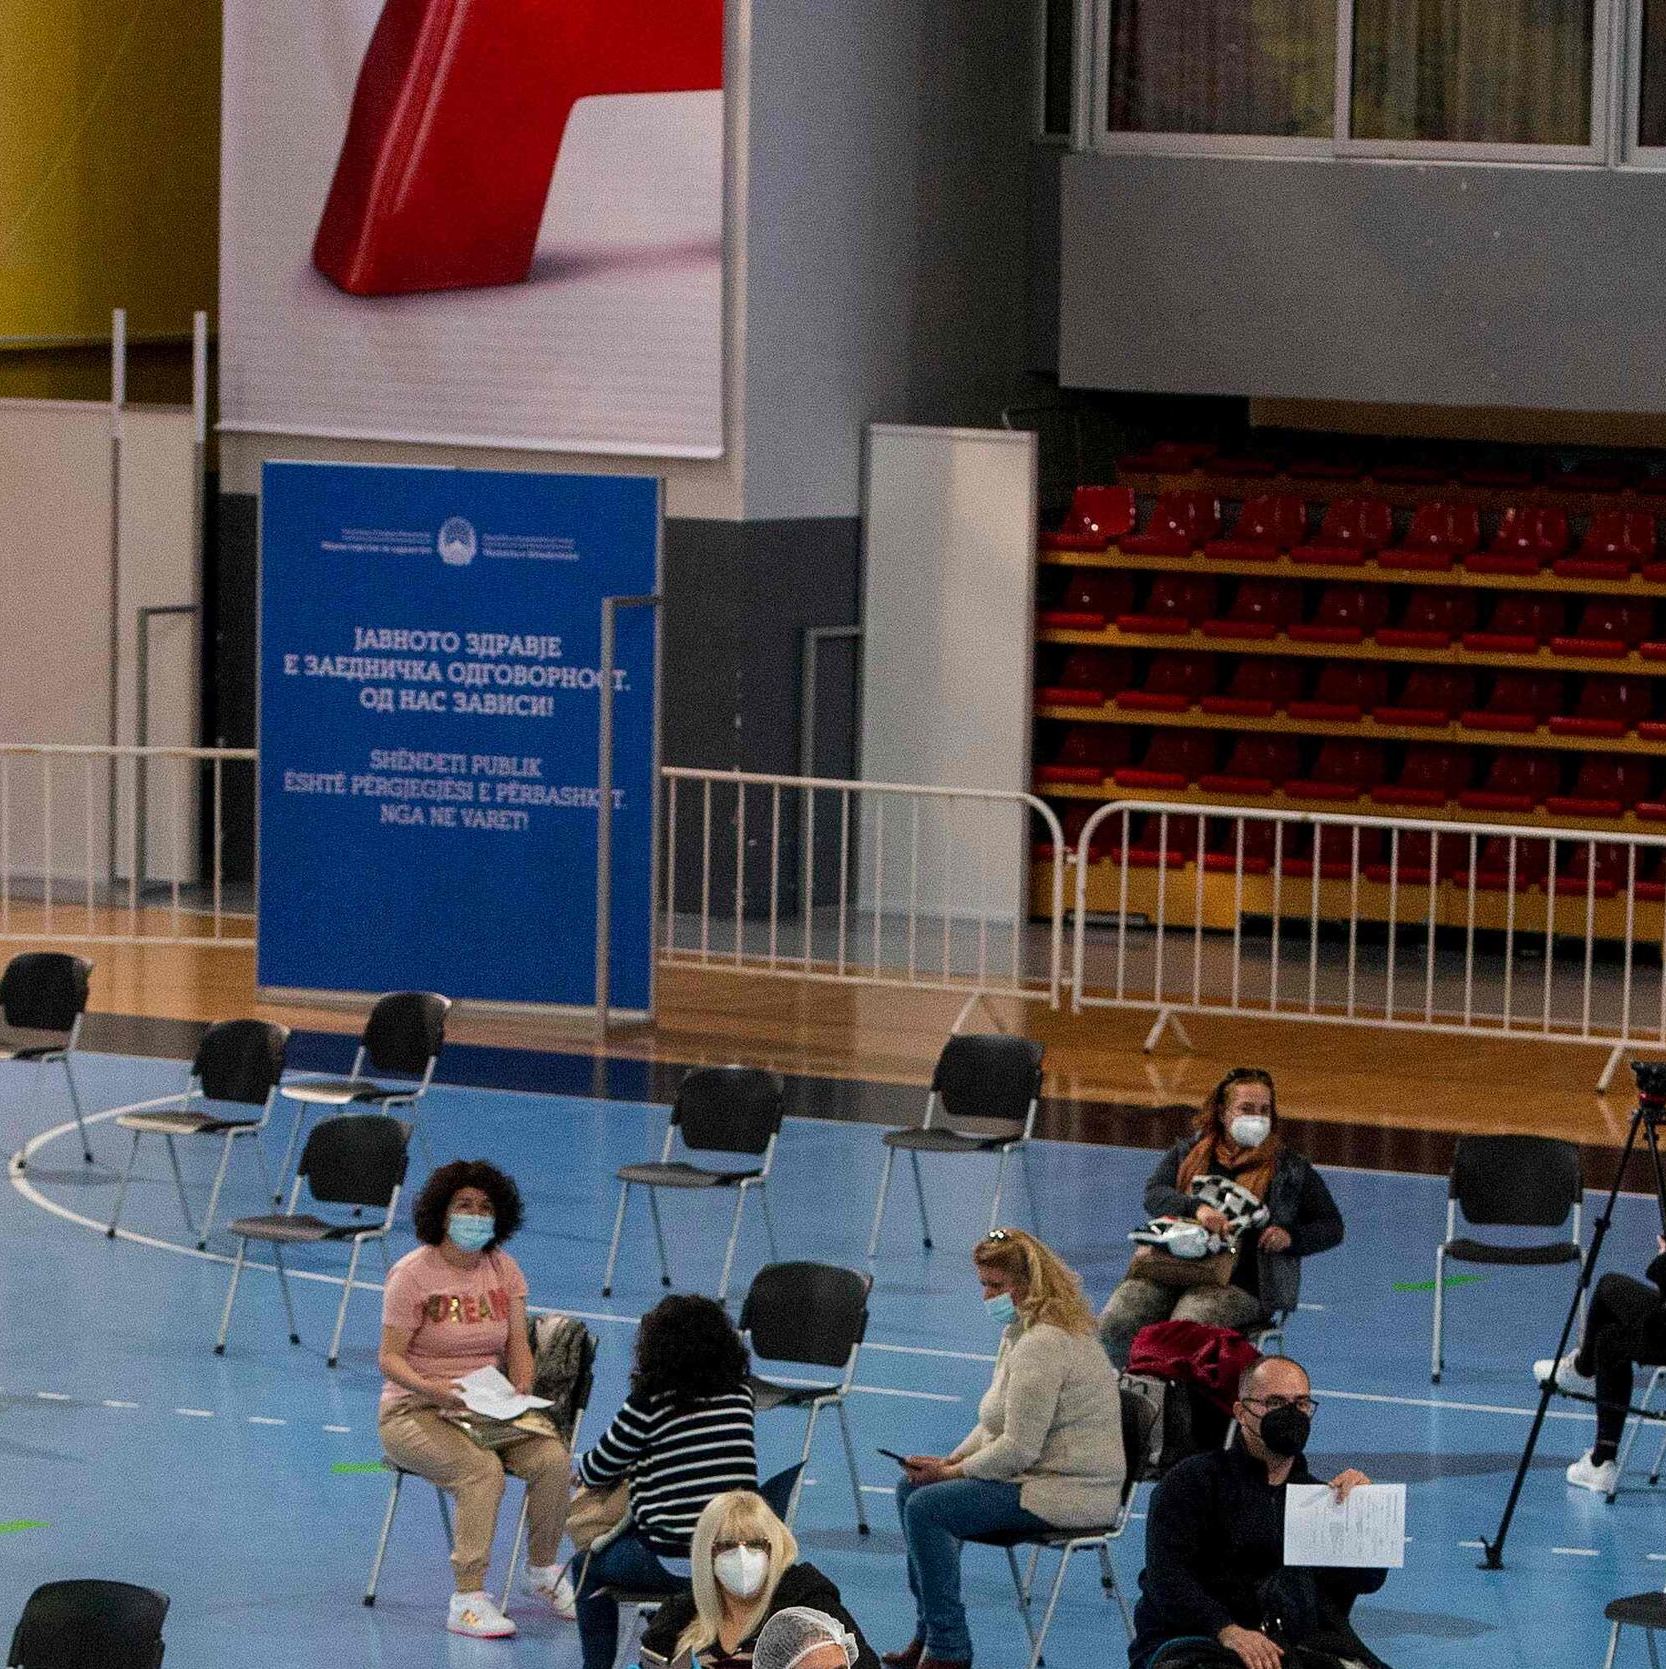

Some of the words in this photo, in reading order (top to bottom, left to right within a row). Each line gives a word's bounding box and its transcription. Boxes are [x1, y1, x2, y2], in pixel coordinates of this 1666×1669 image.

[355, 627, 461, 652] ЈАВНОТО
[465, 634, 563, 659] ЗДРАВЈЕ
[304, 656, 443, 682] ЗАЕДНИЧКА
[359, 687, 394, 712] ОД
[399, 689, 448, 712] НАС
[452, 692, 555, 717] ЗАВИСИ!
[471, 754, 544, 778] PUBLIK
[479, 782, 492, 801] E
[380, 803, 425, 826] NGA
